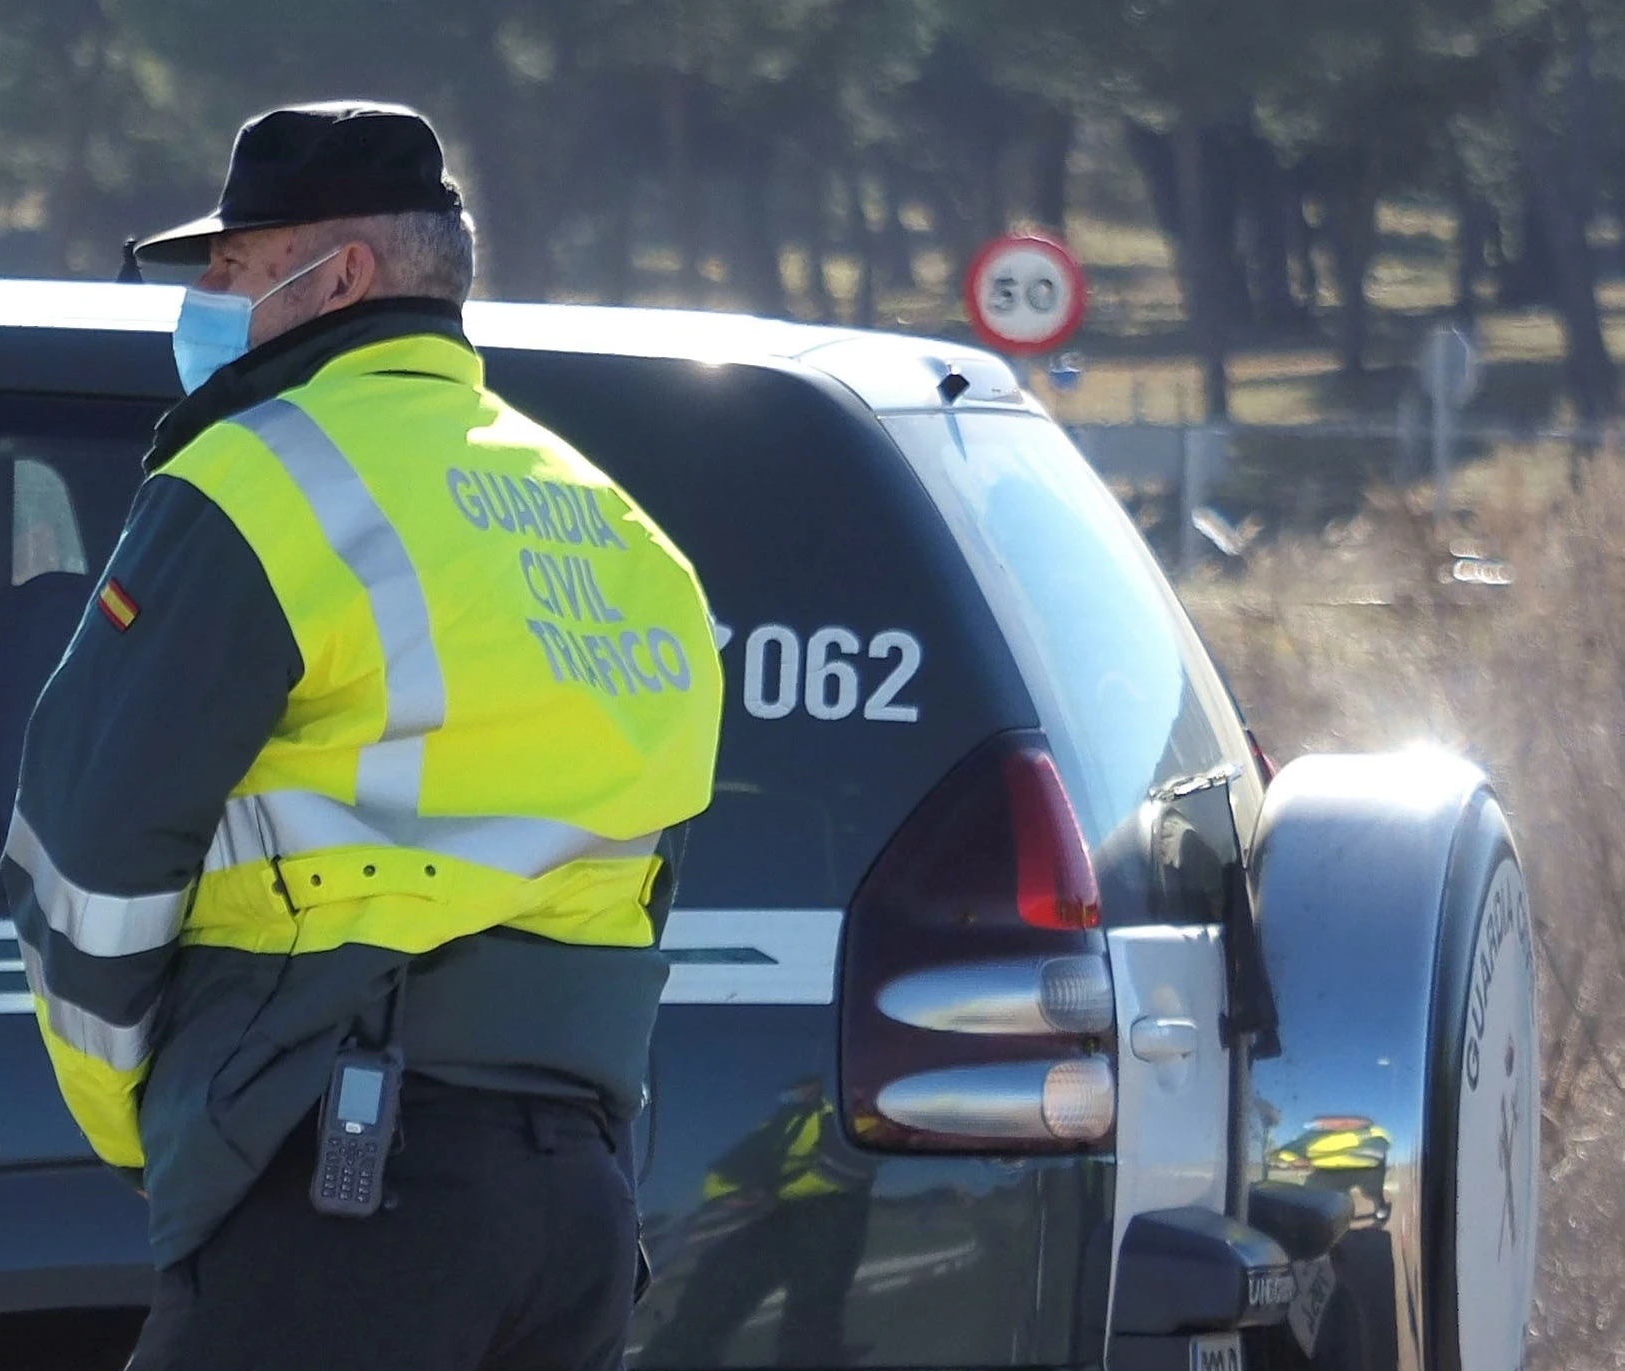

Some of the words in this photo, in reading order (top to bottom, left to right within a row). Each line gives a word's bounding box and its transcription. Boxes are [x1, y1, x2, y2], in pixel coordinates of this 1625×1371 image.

[994, 276, 1054, 313] 50
[446, 467, 629, 550] GUARDIA
[519, 547, 624, 623] CIVIL
[526, 616, 691, 697] TRAFICO
[714, 623, 921, 722] 062
